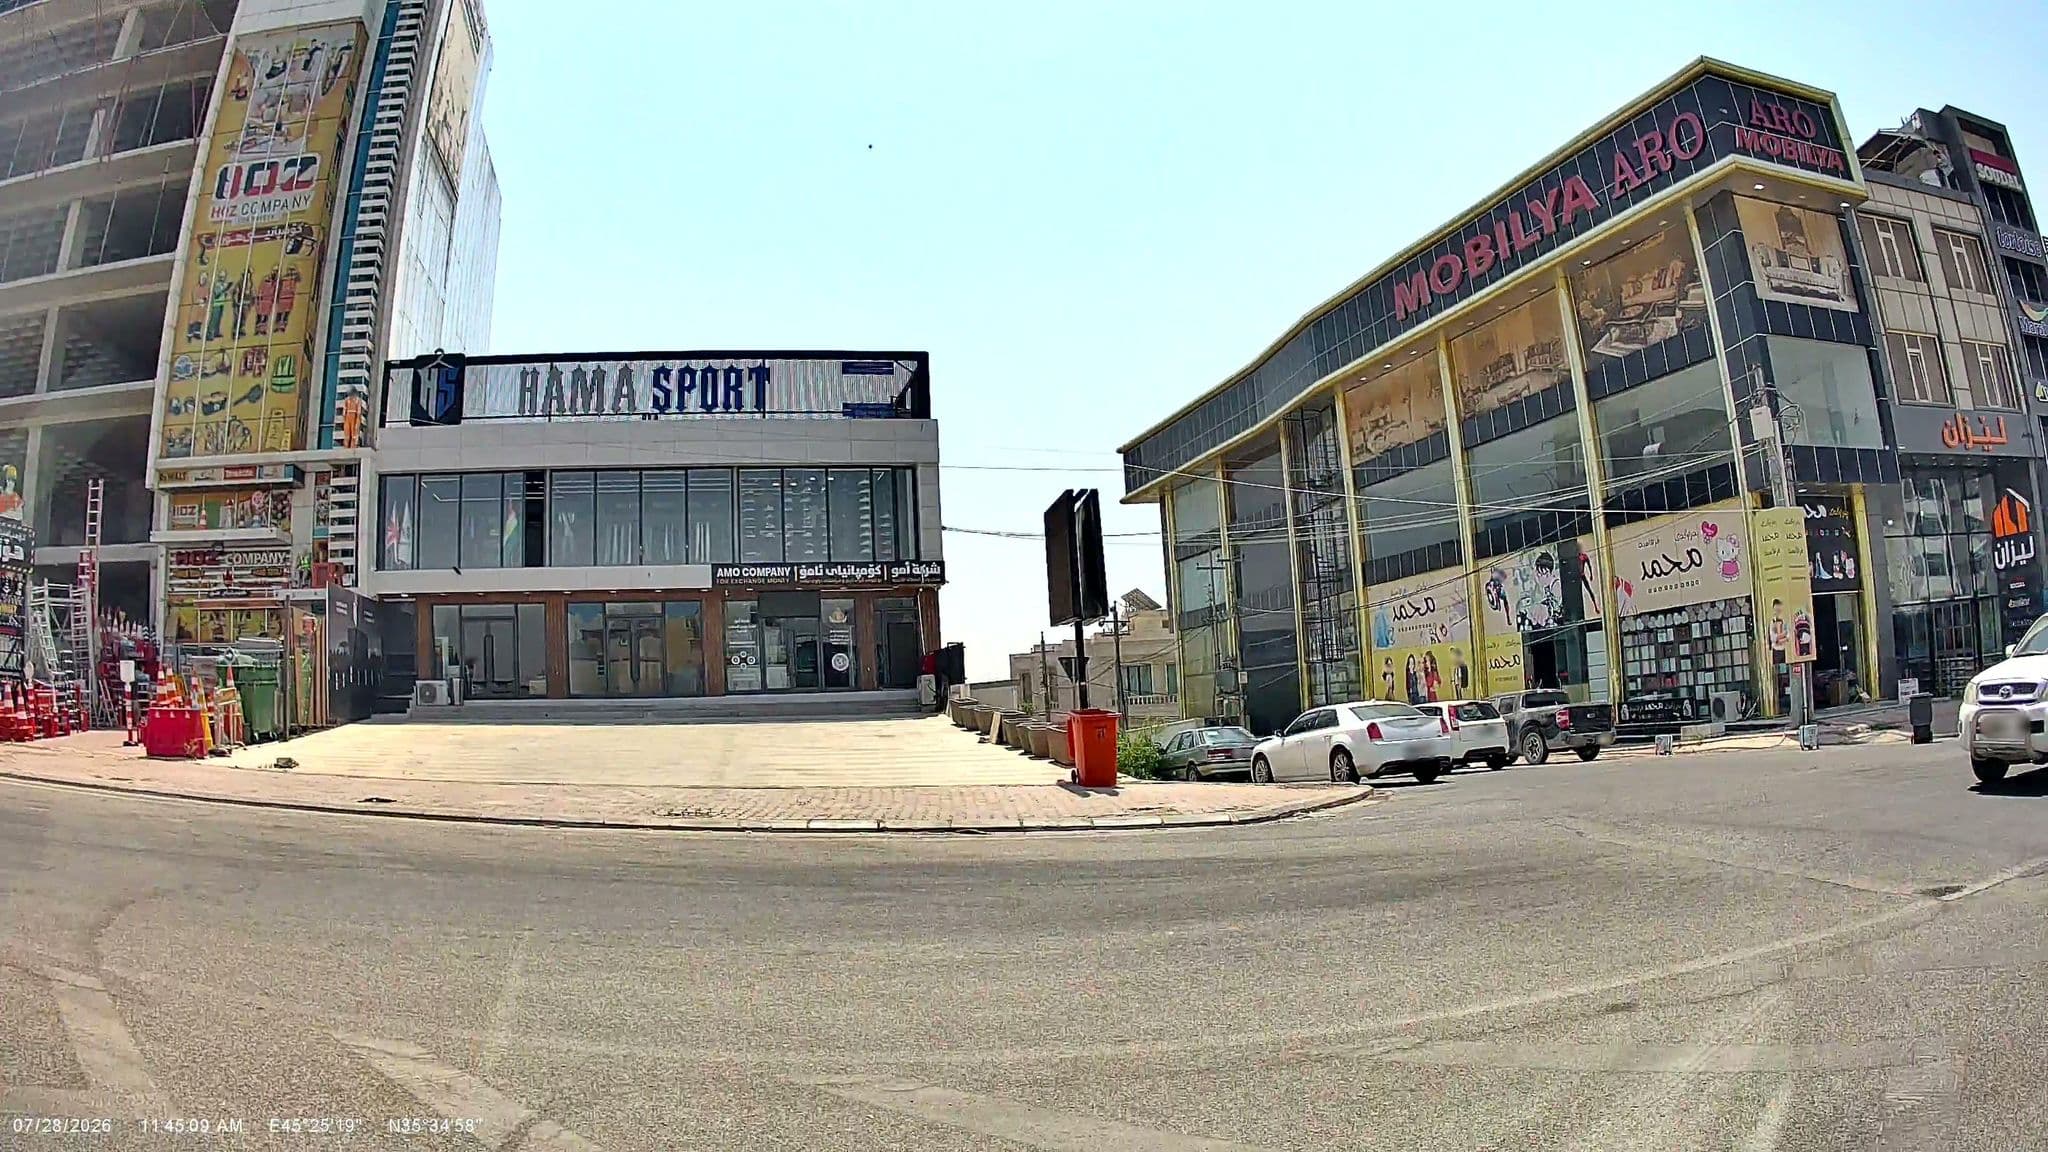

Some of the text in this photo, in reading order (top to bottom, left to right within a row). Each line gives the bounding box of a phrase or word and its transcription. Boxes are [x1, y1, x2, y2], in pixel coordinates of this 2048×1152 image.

[1749, 100, 1817, 139] ARO
[1735, 127, 1845, 171] MOBILYA
[241, 195, 311, 215] COMPANY
[1393, 111, 1705, 321] MOBILYA ARO
[518, 362, 770, 416] HAMA SPORT
[225, 551, 286, 565] COMPANY
[716, 566, 791, 577] AMO COMPANY
